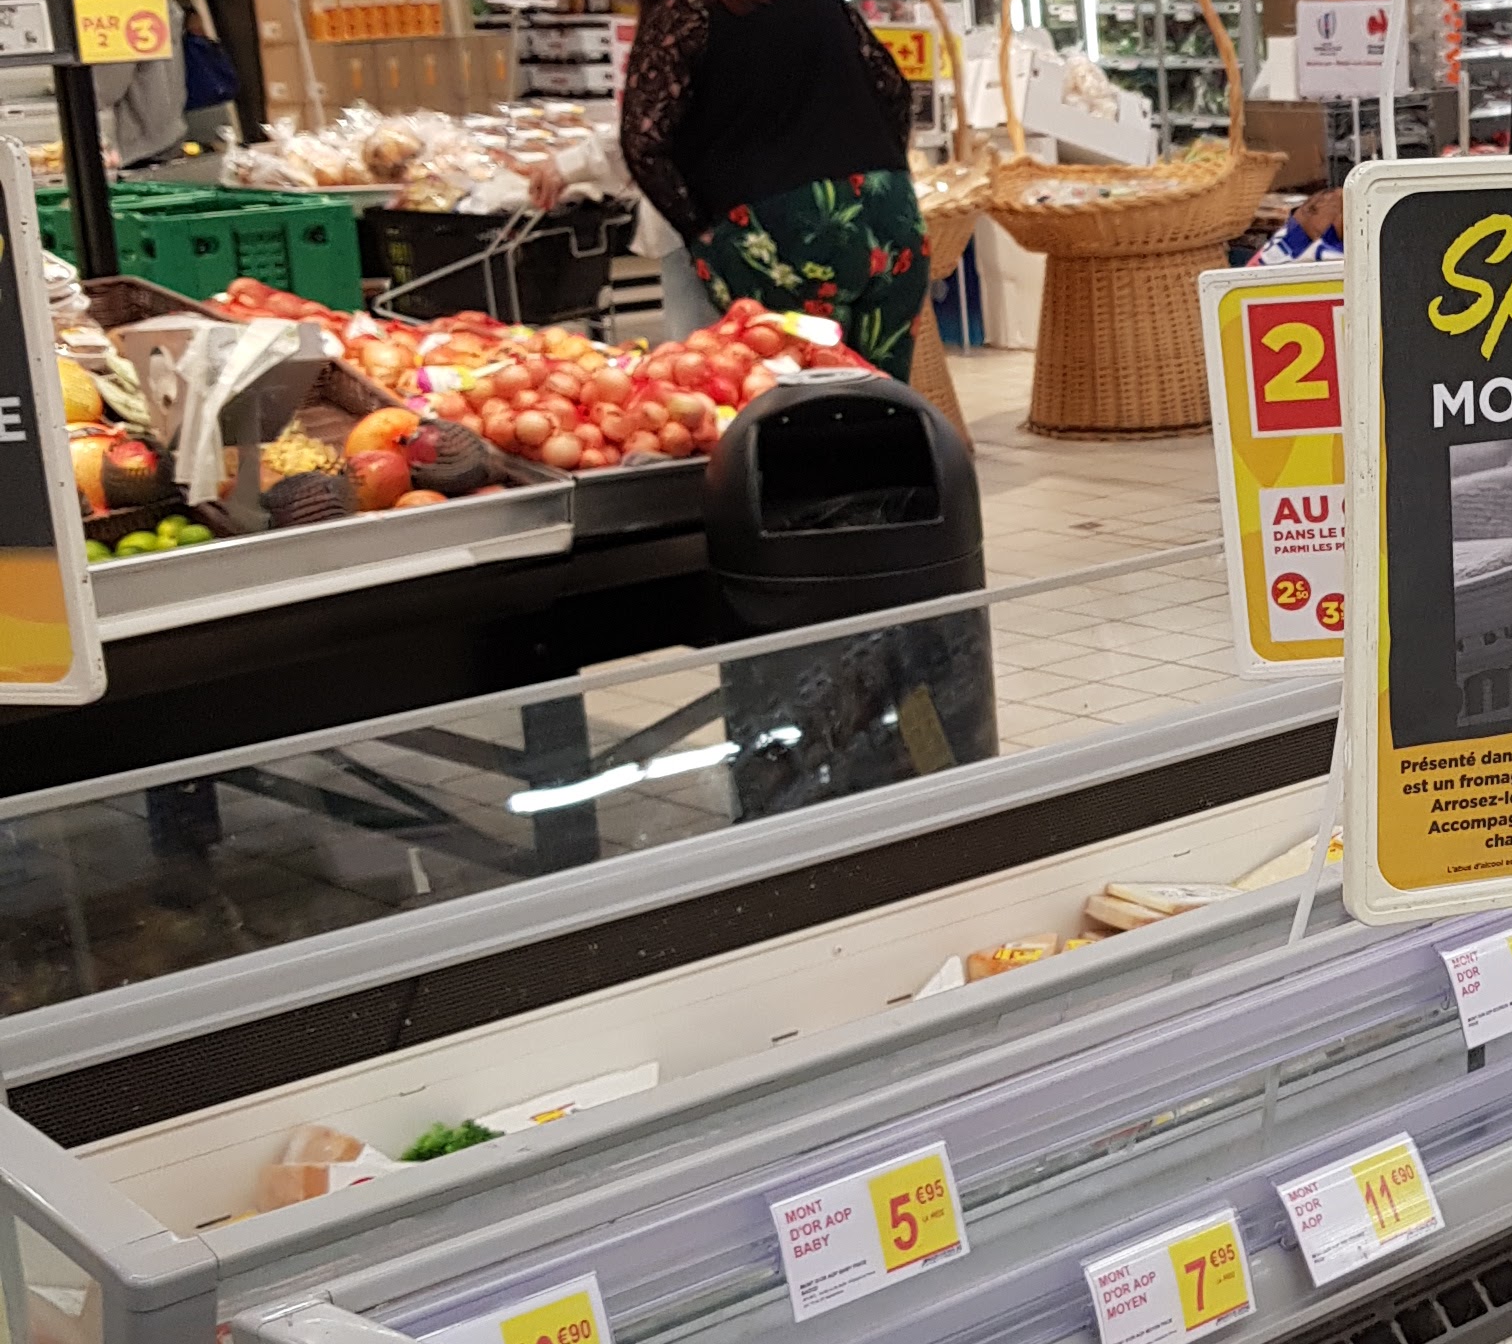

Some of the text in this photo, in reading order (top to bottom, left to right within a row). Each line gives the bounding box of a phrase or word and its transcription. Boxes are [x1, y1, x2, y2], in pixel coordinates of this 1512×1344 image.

[1260, 322, 1330, 402] 2
[1273, 495, 1329, 525] AU
[1274, 528, 1337, 541] DANS LE
[1274, 543, 1332, 554] PARMI LES
[1401, 752, 1476, 774] Présenté
[1403, 779, 1428, 795] est
[1433, 779, 1454, 792] un
[1452, 952, 1478, 969] MONT
[1456, 967, 1480, 983] D'OR
[1462, 982, 1480, 997] AOP
[785, 1200, 822, 1224] MONT
[790, 1208, 852, 1242] D'OR AOP
[793, 1234, 830, 1258] BABY
[1106, 1292, 1148, 1320] MOYEN
